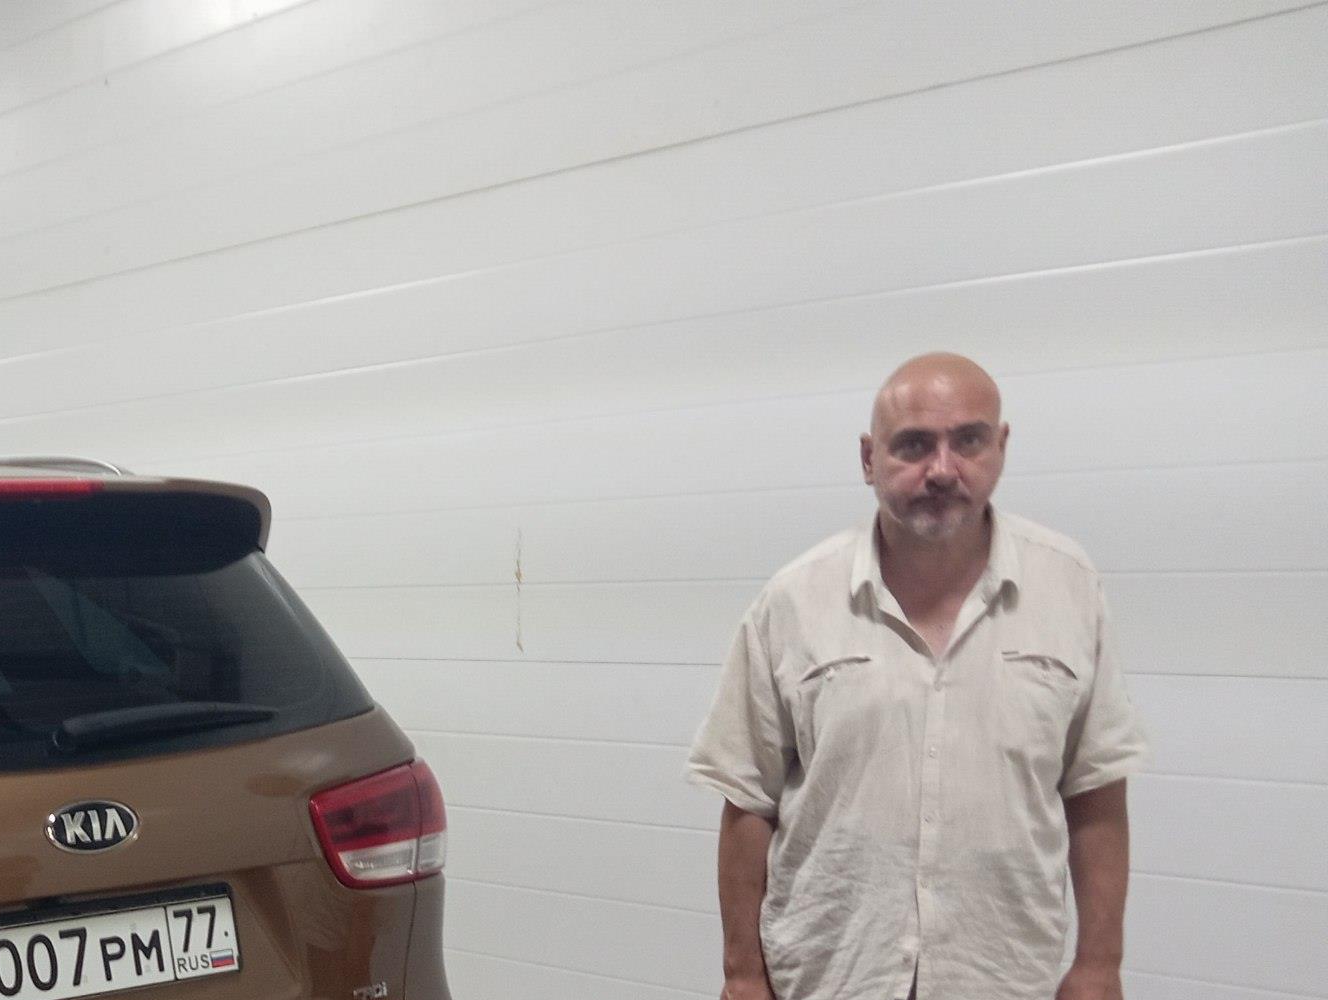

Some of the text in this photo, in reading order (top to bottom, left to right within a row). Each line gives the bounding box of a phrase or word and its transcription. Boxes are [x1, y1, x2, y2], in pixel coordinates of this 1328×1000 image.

[60, 807, 127, 845] KIA
[172, 905, 216, 953] 77
[177, 954, 210, 972] RUS
